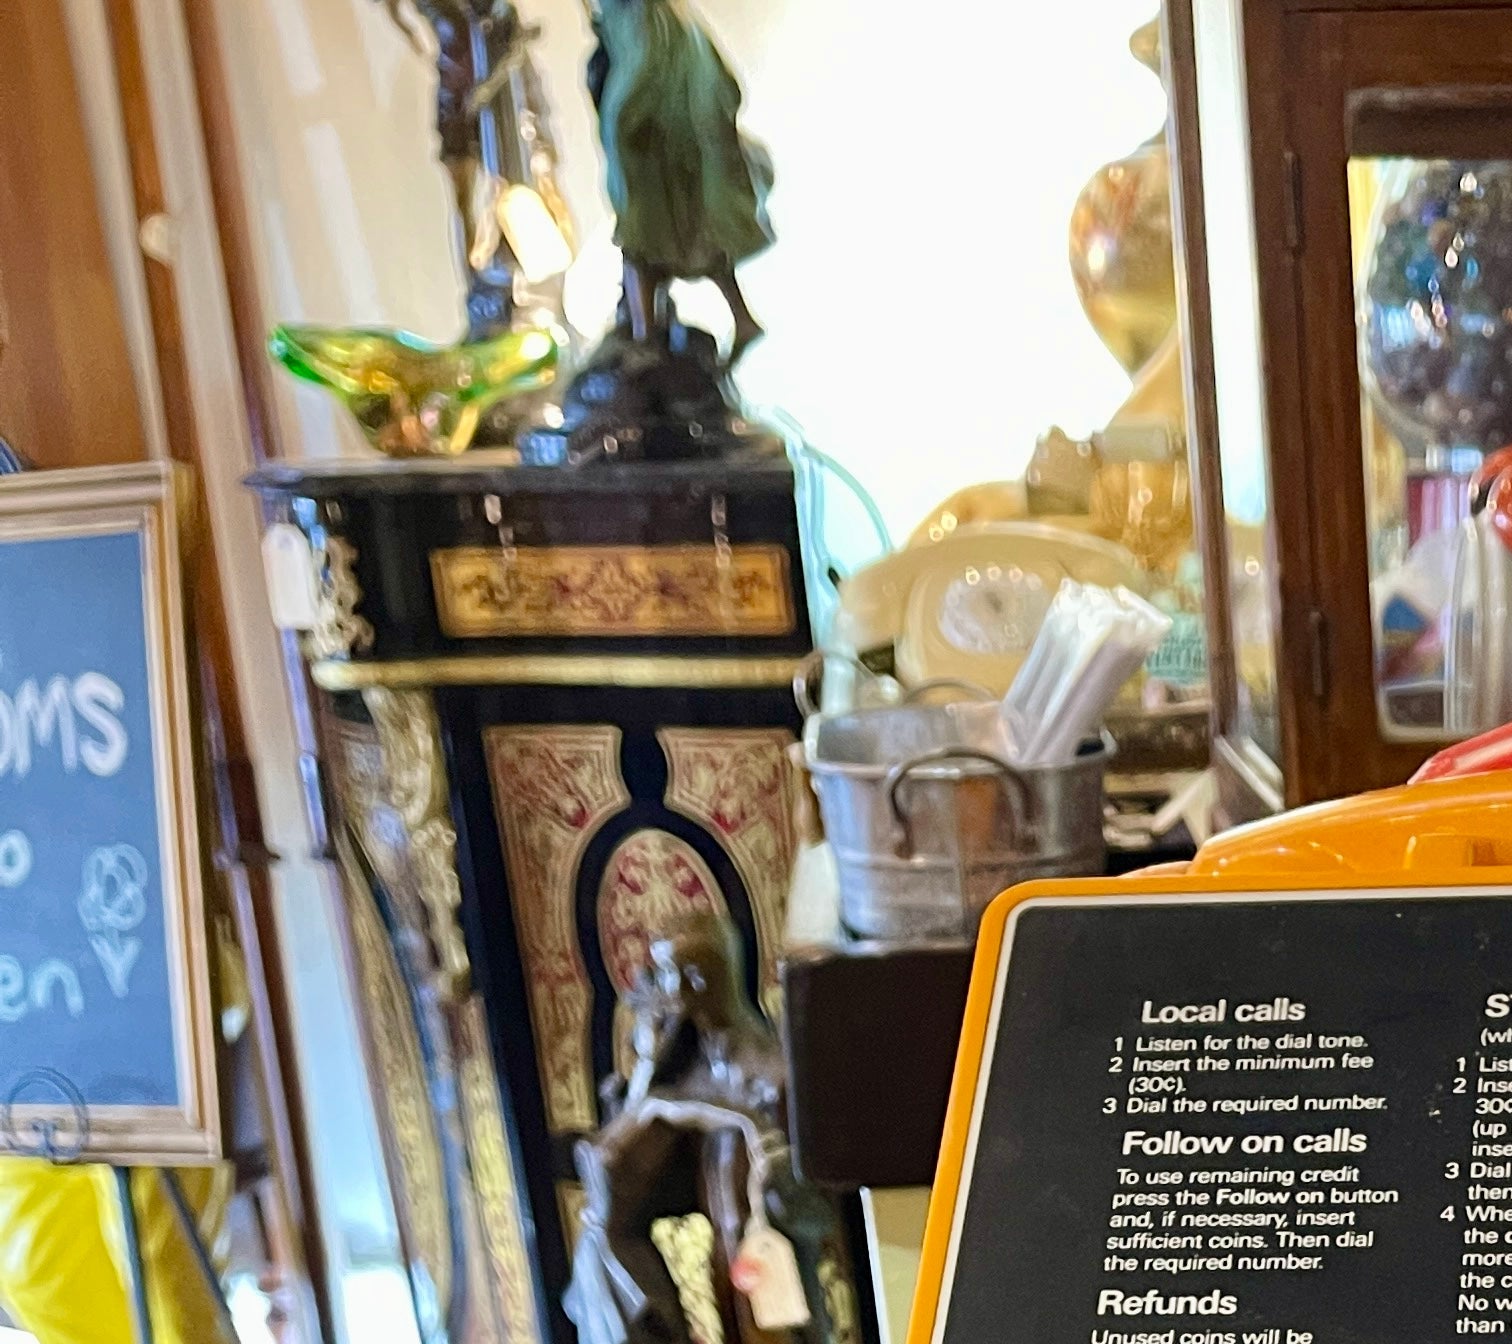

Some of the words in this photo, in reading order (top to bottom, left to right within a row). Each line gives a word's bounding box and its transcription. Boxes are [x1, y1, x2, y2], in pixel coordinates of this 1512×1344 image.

[1141, 998, 1227, 1024] Local
[1234, 997, 1307, 1023] calls
[1114, 1036, 1124, 1053] 1
[1135, 1036, 1198, 1053] Listen
[1203, 1034, 1233, 1051] for
[1236, 1034, 1271, 1051] the
[1274, 1032, 1313, 1050] dial
[1318, 1034, 1369, 1049] tone.
[1107, 1056, 1124, 1073] 2
[1132, 1056, 1191, 1073] Insert
[1196, 1055, 1231, 1072] the
[1234, 1054, 1336, 1071] minimum
[1341, 1052, 1375, 1069] fee
[1456, 1056, 1467, 1073] 1
[1101, 1096, 1118, 1115] 3
[1126, 1096, 1168, 1114] Dial
[1172, 1096, 1208, 1114] the
[1212, 1094, 1300, 1116] required
[1303, 1093, 1388, 1111] number.
[1121, 1130, 1235, 1156] Follow
[1240, 1134, 1285, 1155] on
[1292, 1127, 1368, 1154] calls
[1116, 1167, 1140, 1185] To
[1145, 1171, 1184, 1185] use
[1188, 1166, 1296, 1187] remaining
[1300, 1165, 1360, 1183] credit
[1444, 1161, 1460, 1180] 3
[1469, 1161, 1512, 1179] Dial
[1105, 1231, 1204, 1250] sufficient
[1207, 1231, 1269, 1250] coins.
[1275, 1230, 1331, 1249] Then
[1335, 1230, 1375, 1248] dial
[1463, 1226, 1500, 1245] the
[1103, 1254, 1139, 1272] the
[1143, 1253, 1234, 1275] required
[1237, 1252, 1324, 1271] number.
[1096, 1288, 1238, 1316] Refunds
